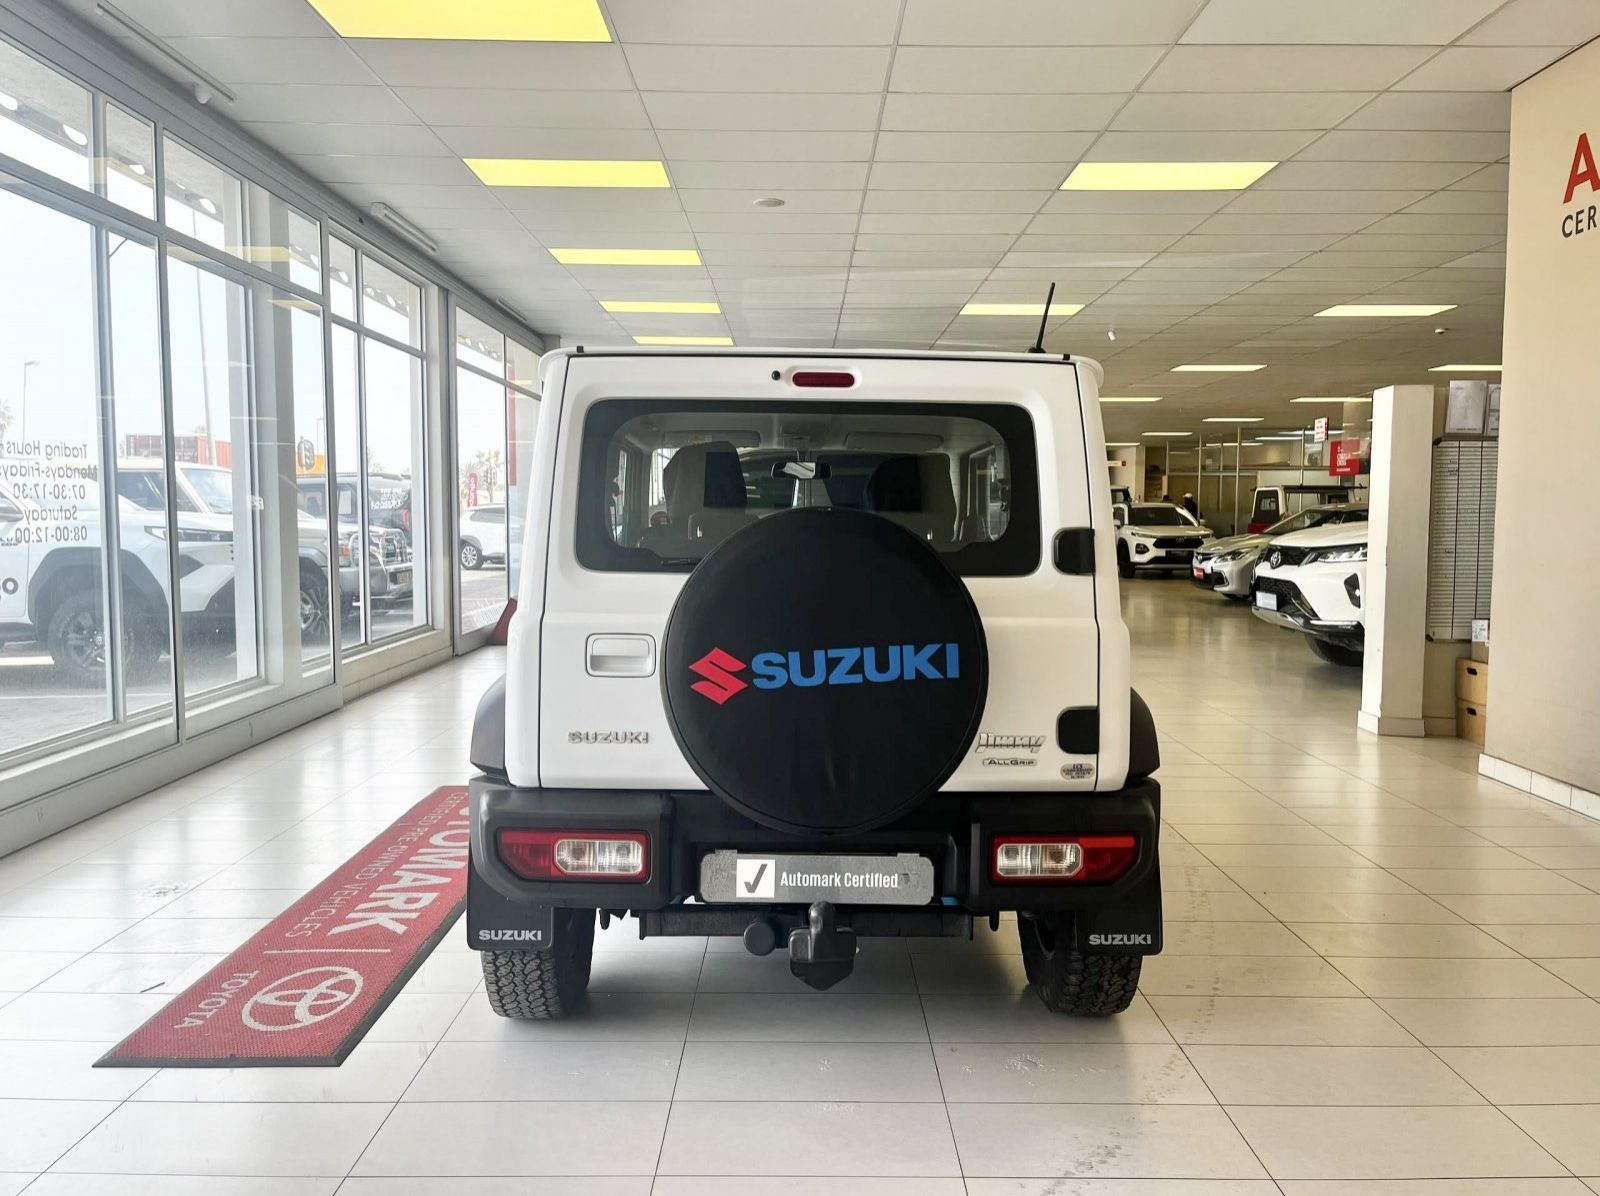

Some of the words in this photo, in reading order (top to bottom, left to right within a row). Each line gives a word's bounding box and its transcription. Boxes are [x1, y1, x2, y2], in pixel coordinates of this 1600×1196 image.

[752, 643, 960, 690] SUZUKI
[567, 731, 650, 745] SUZUKI
[780, 871, 842, 888] Automark
[844, 872, 899, 889] Certified
[284, 882, 369, 940] VEHICLES
[478, 929, 542, 941] SUZUKI
[1088, 933, 1152, 946] SUZUKI
[173, 970, 260, 1029] TOYOTA
